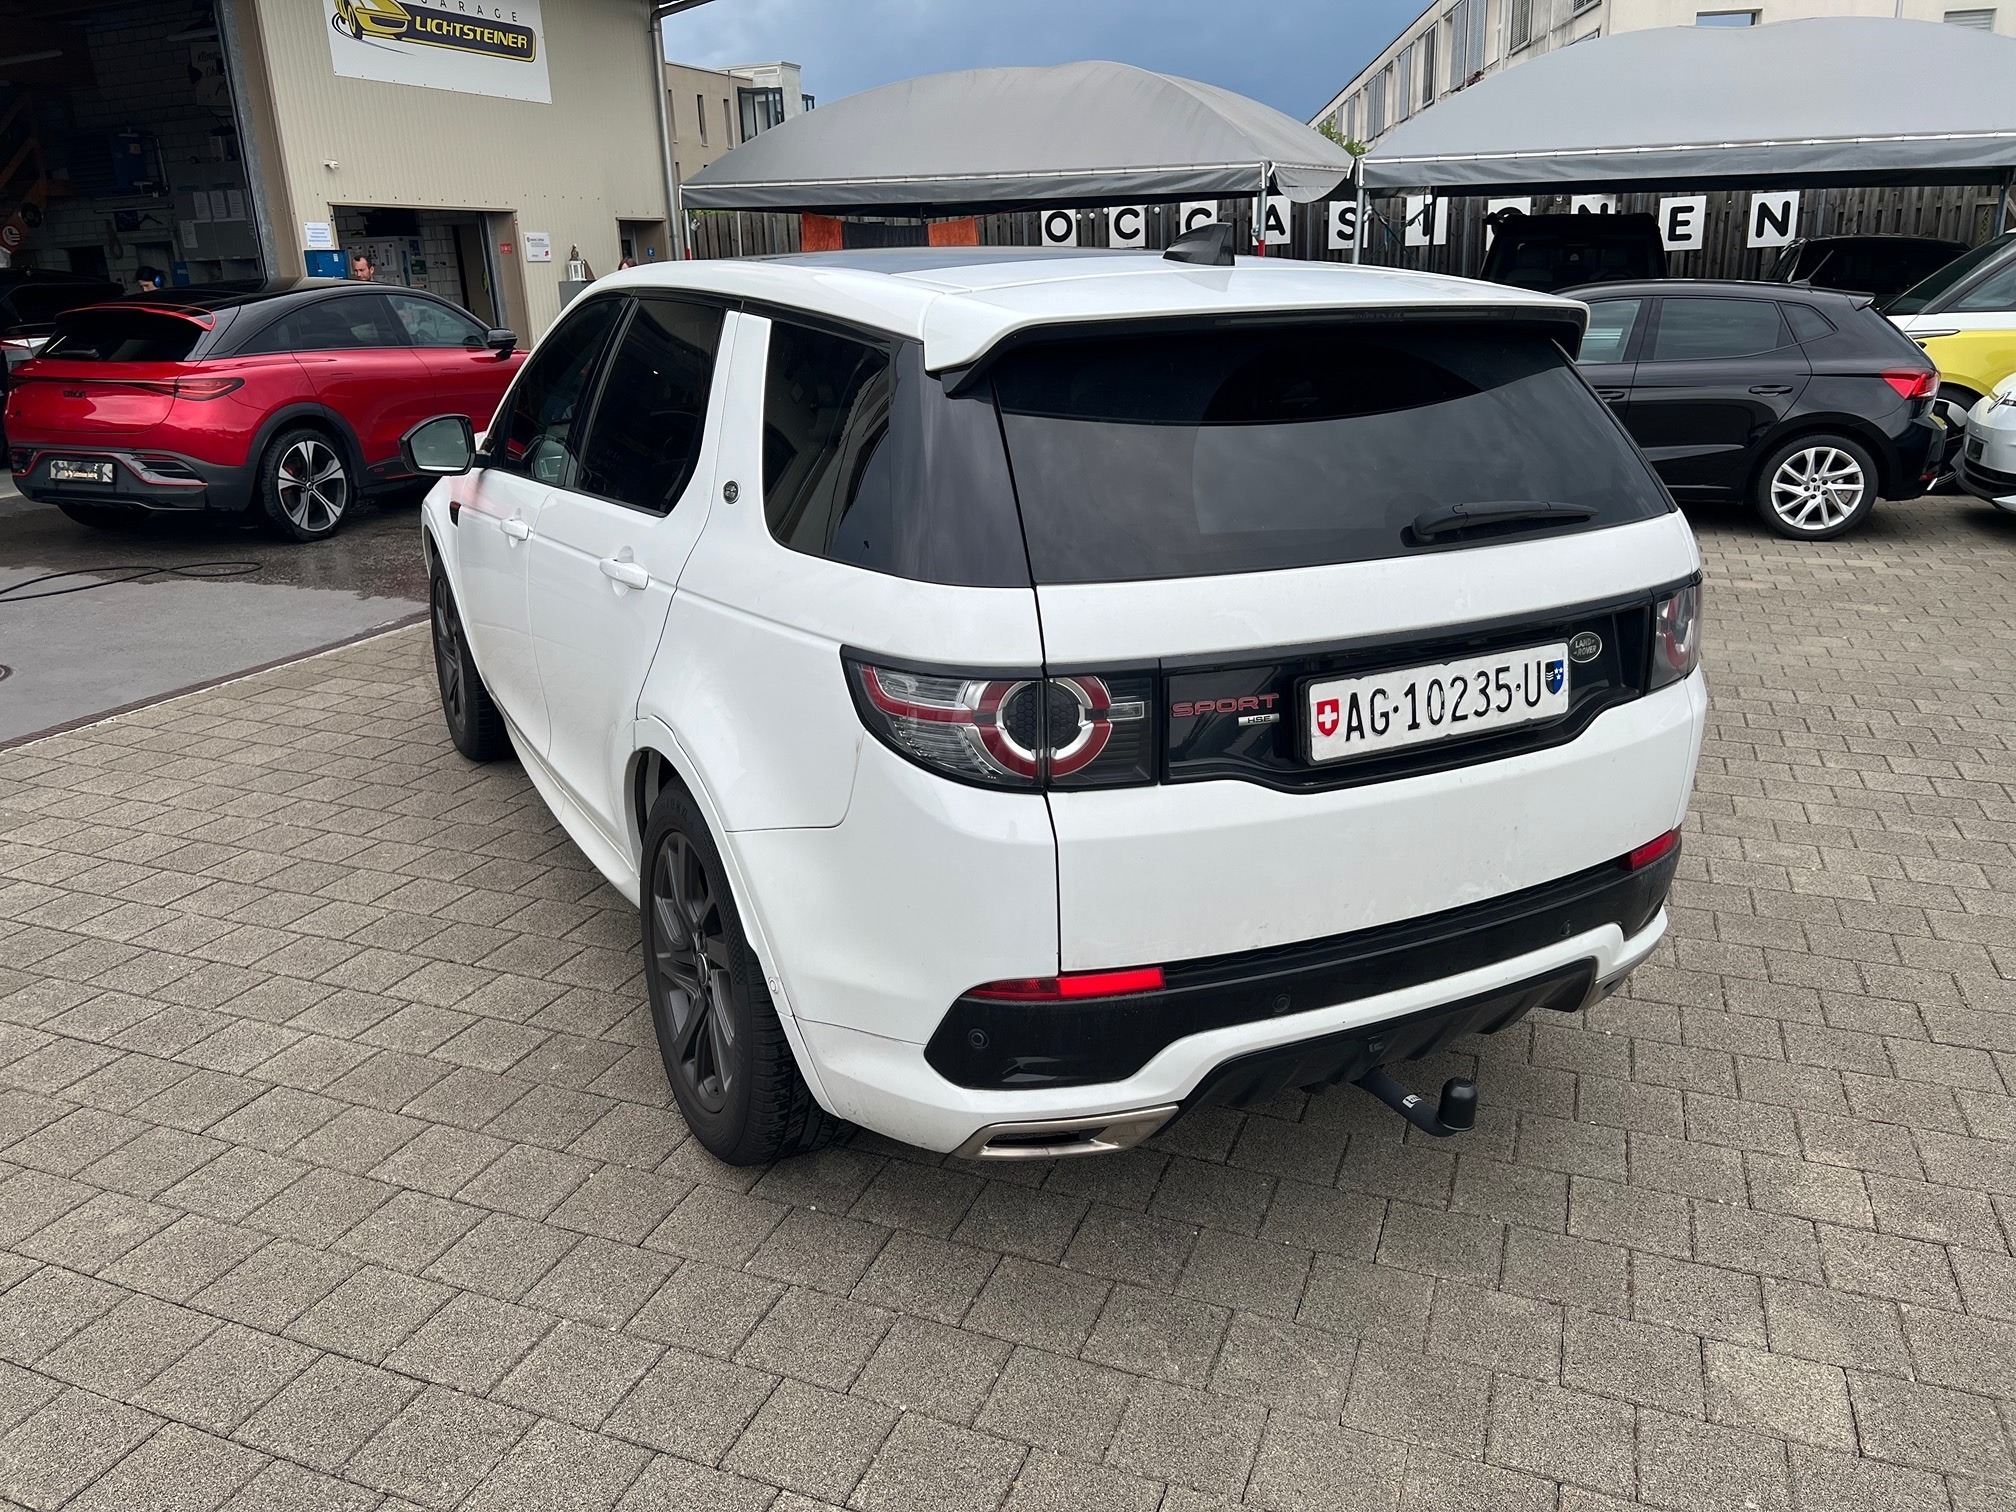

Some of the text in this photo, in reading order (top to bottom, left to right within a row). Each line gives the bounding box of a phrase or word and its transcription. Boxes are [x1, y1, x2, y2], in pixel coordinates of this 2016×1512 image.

[415, 16, 528, 49] LICHTSTEINER
[1575, 637, 1592, 649] LAND
[1576, 645, 1597, 657] ROVER
[1172, 693, 1279, 718] SPORT
[1247, 715, 1272, 724] HSE
